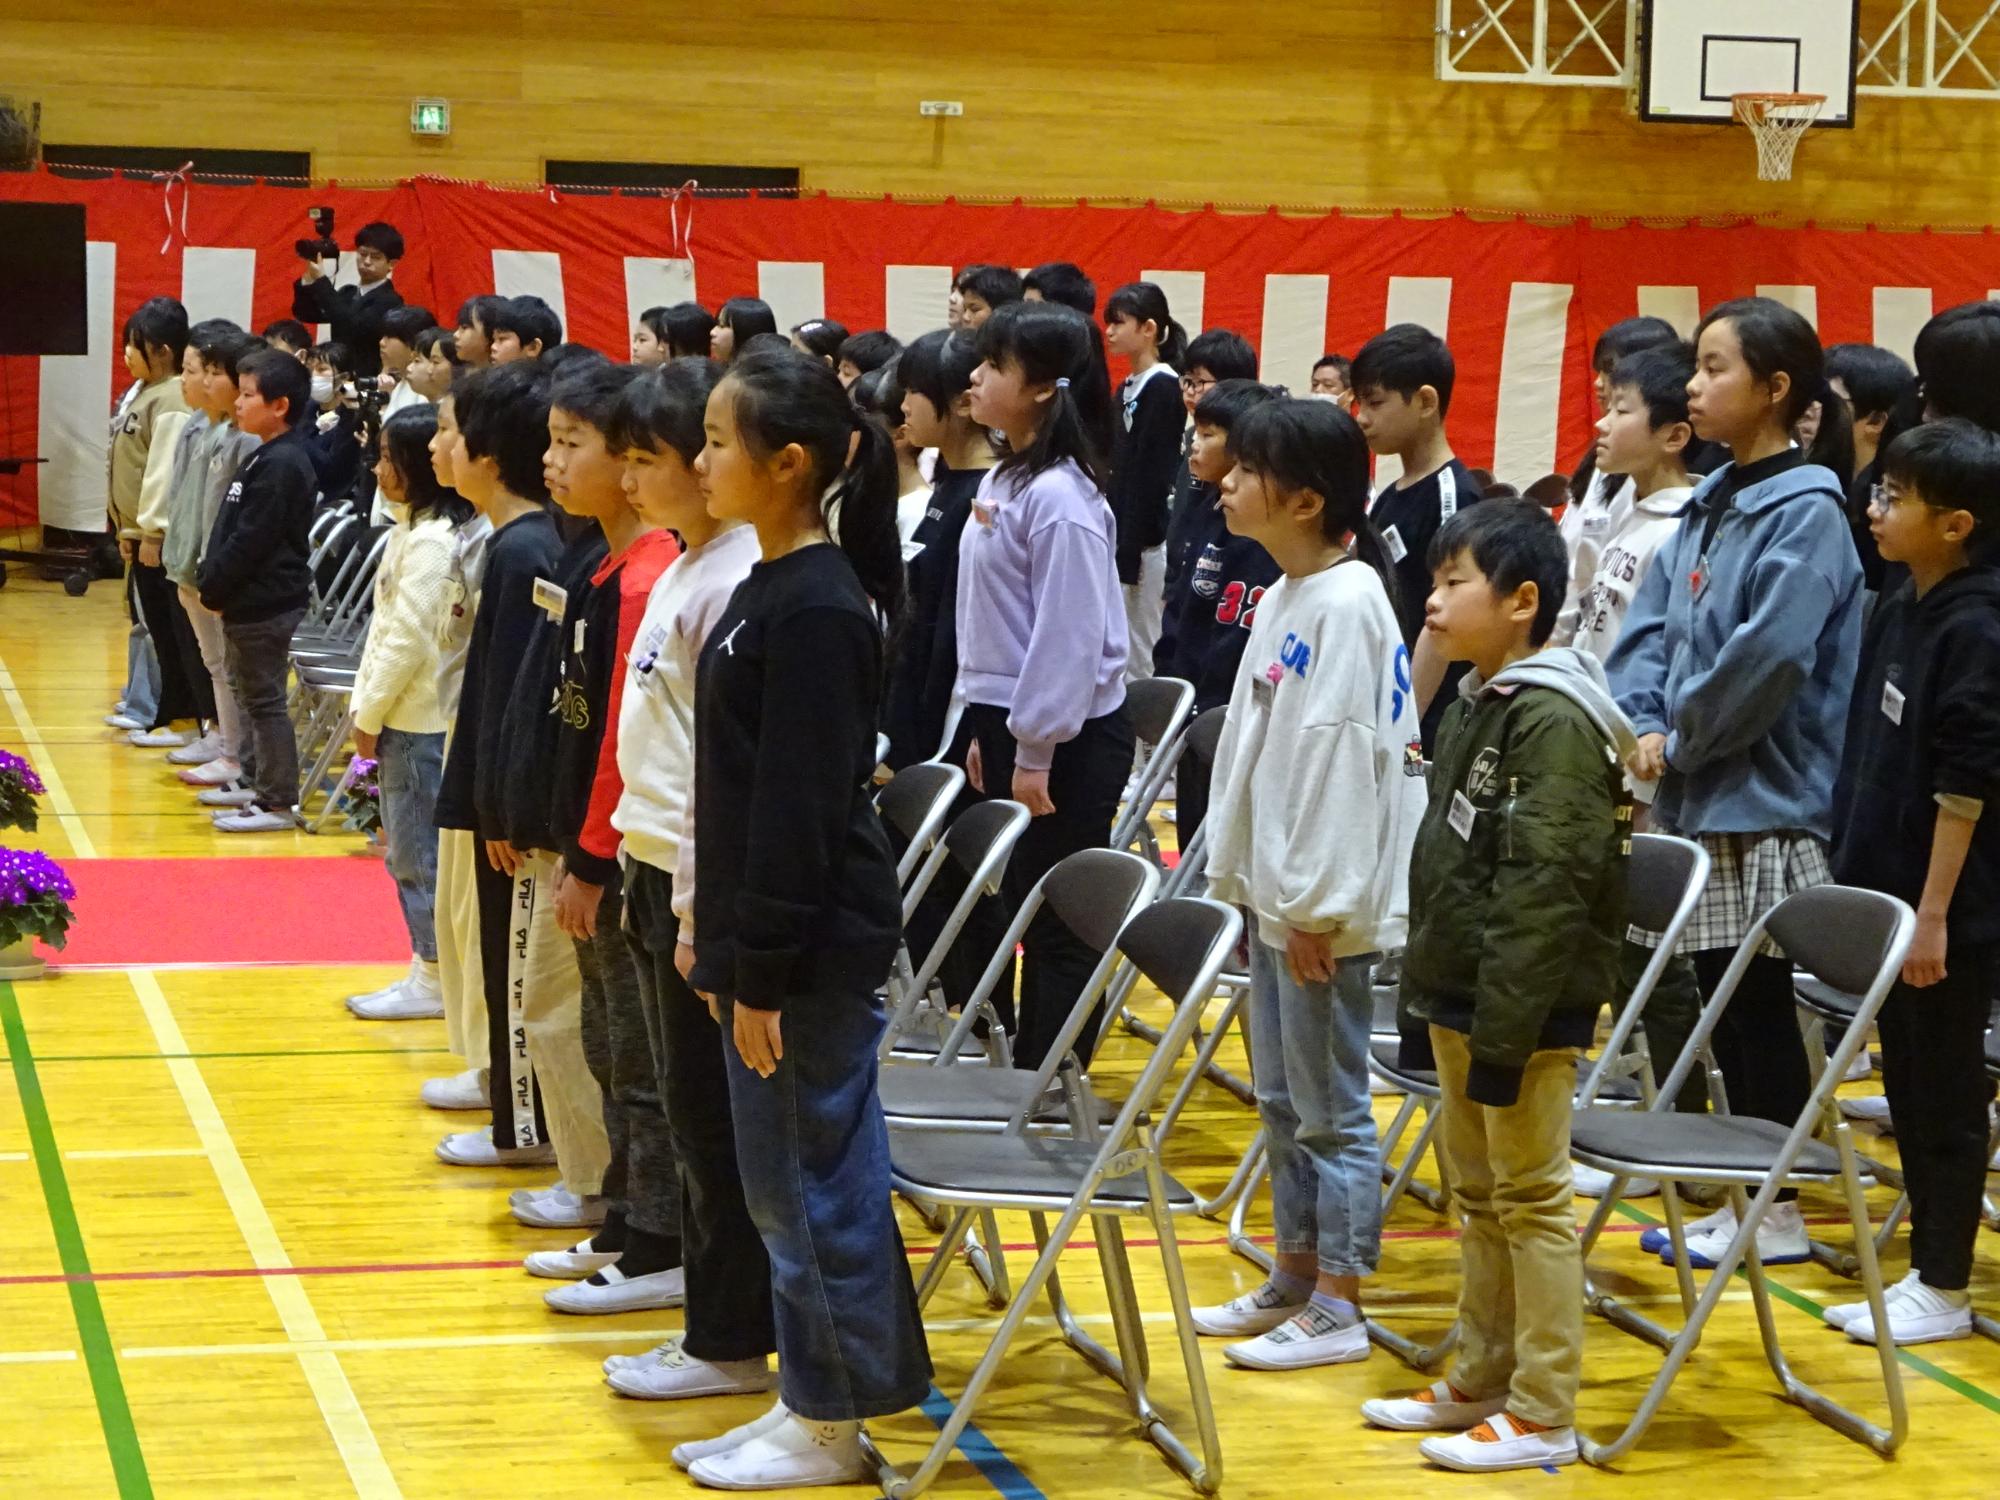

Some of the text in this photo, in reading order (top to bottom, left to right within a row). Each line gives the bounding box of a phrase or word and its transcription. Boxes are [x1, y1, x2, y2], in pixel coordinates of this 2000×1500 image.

[518, 878, 532, 910] FILA
[515, 928, 527, 959] FILA
[514, 1027, 527, 1058] FILA
[516, 1075, 530, 1107] FILA
